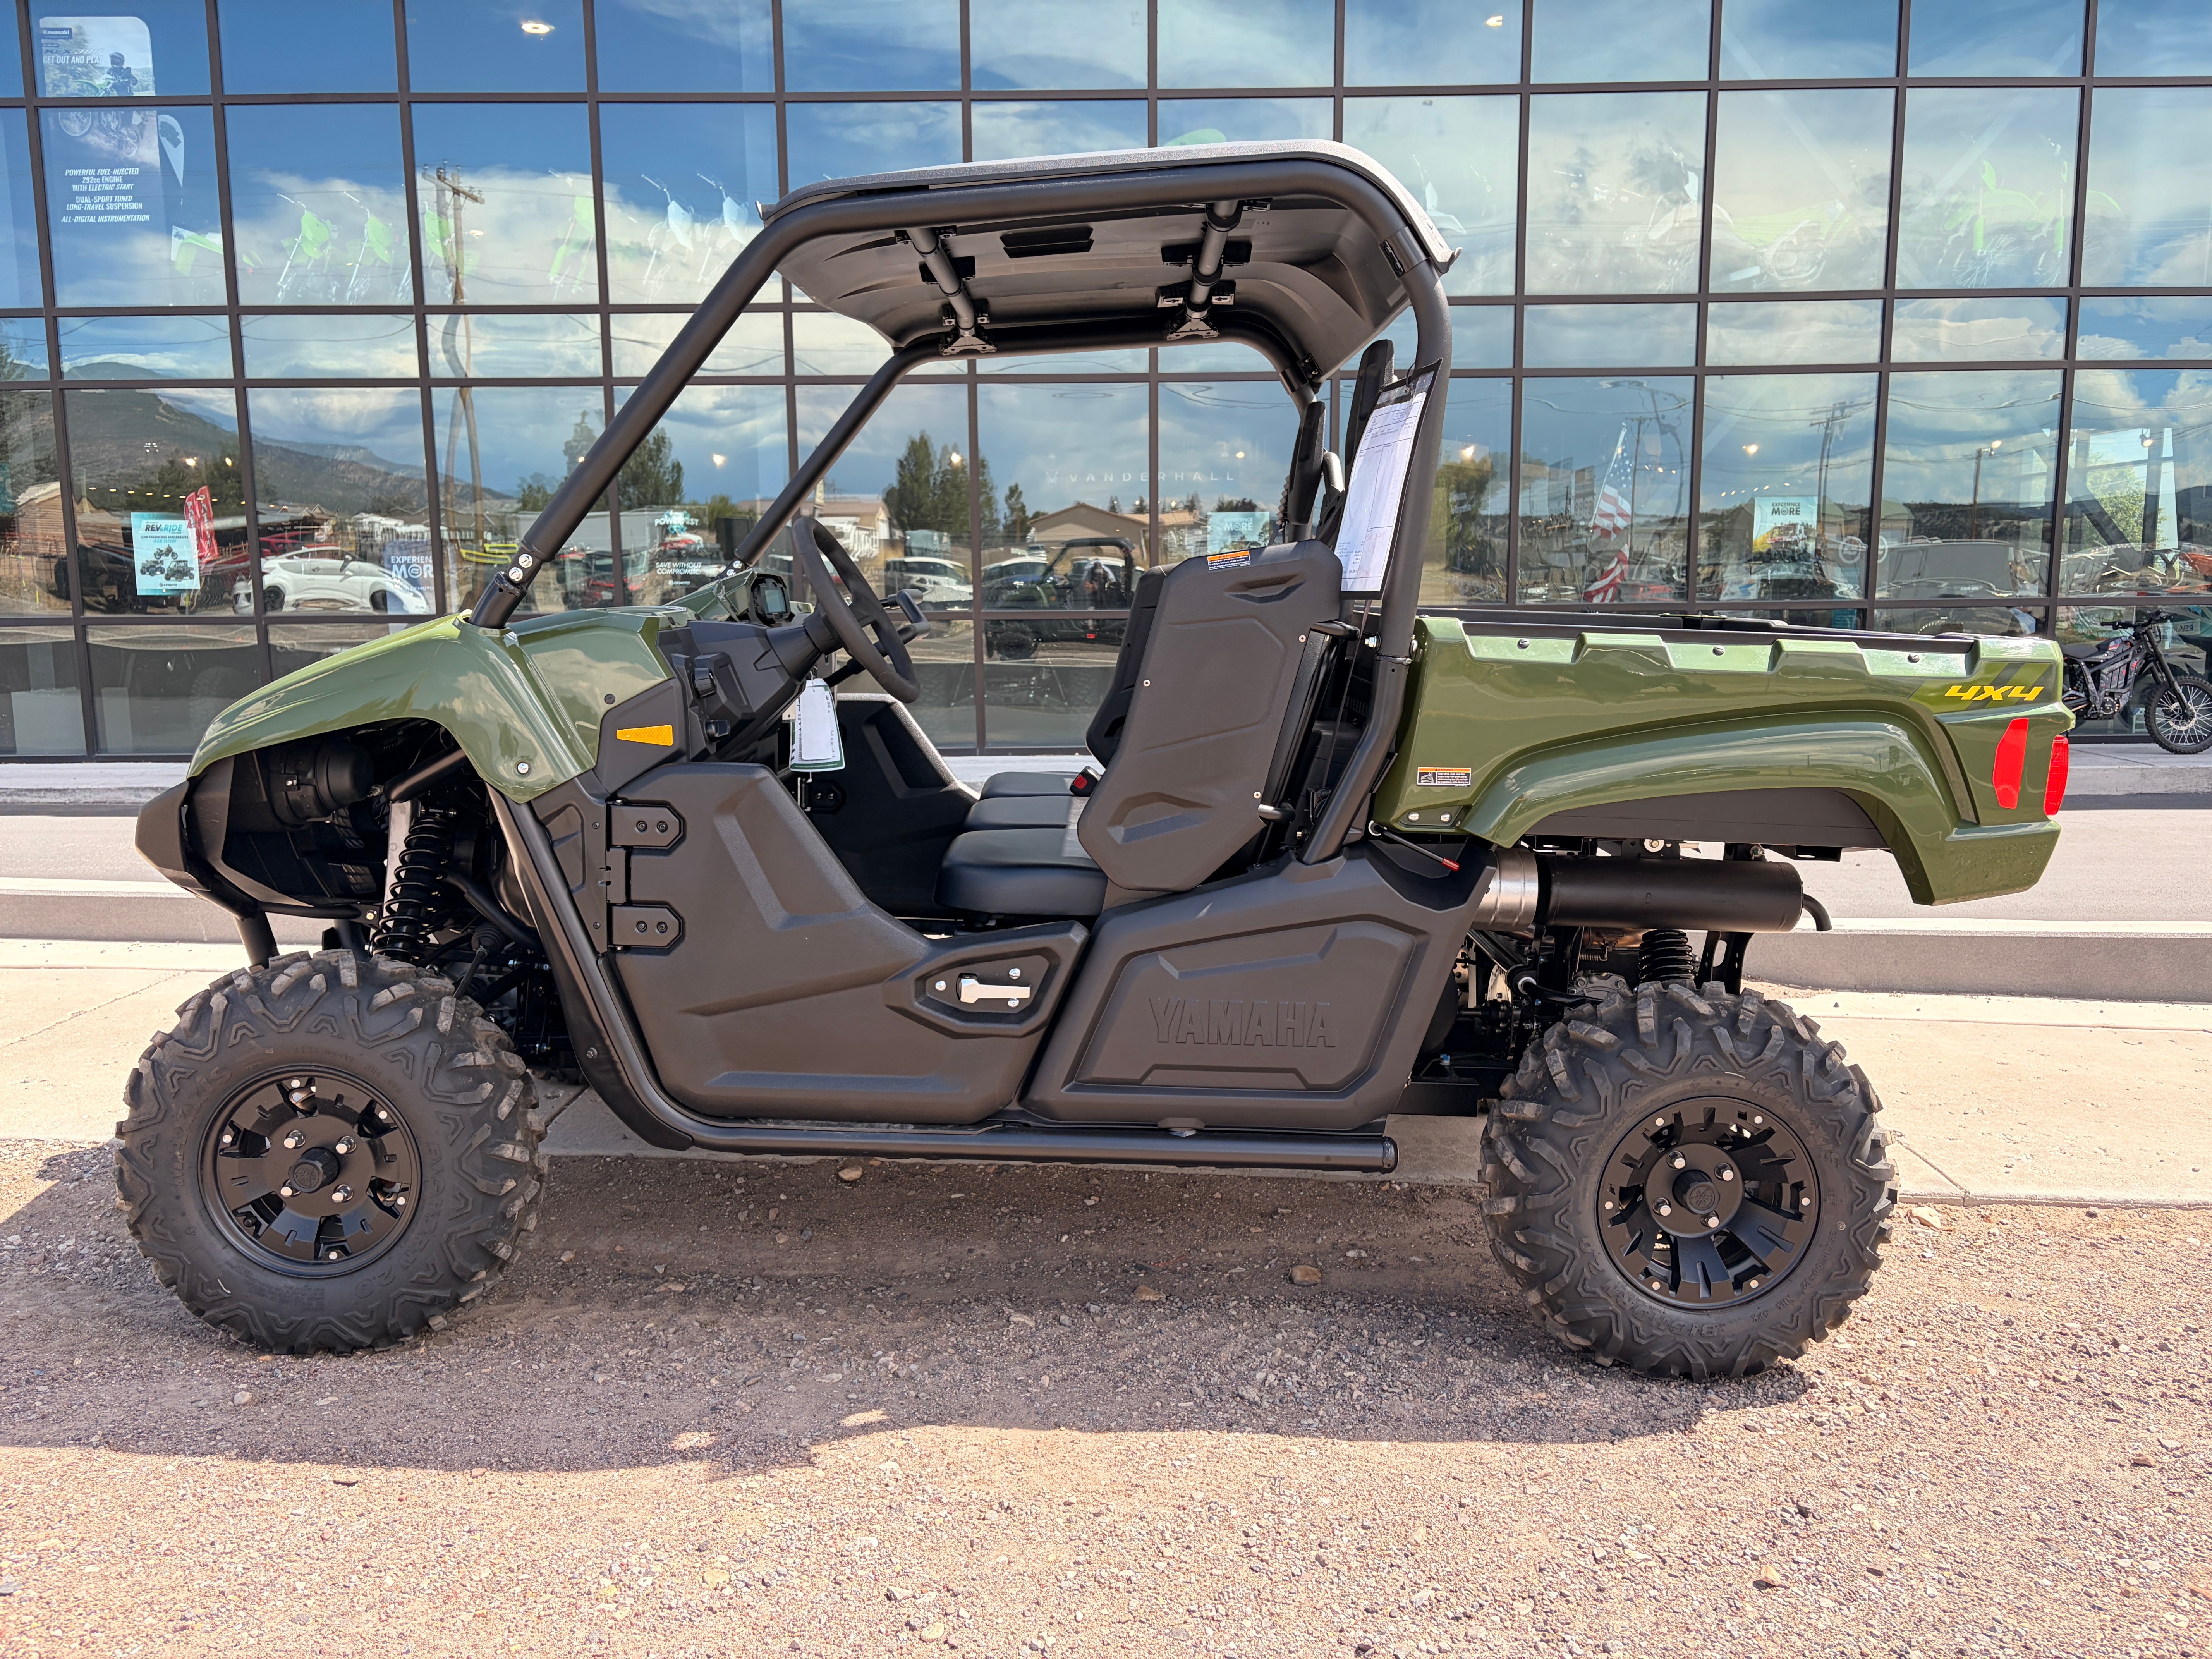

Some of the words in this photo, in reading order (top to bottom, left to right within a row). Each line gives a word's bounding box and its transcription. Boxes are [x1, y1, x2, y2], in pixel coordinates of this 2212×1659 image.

[86, 55, 103, 64] PLAY
[1070, 472, 1234, 482] VANDERHALL
[392, 564, 434, 578] MOR
[1945, 685, 2044, 701] 4X4
[1149, 998, 1336, 1047] YAMAHA
[166, 1066, 232, 1186] MAXXIS
[1748, 1080, 1840, 1169] MAXXIS
[399, 1142, 445, 1271] BIGHORN
[1600, 1279, 1719, 1337] BIGHORN
